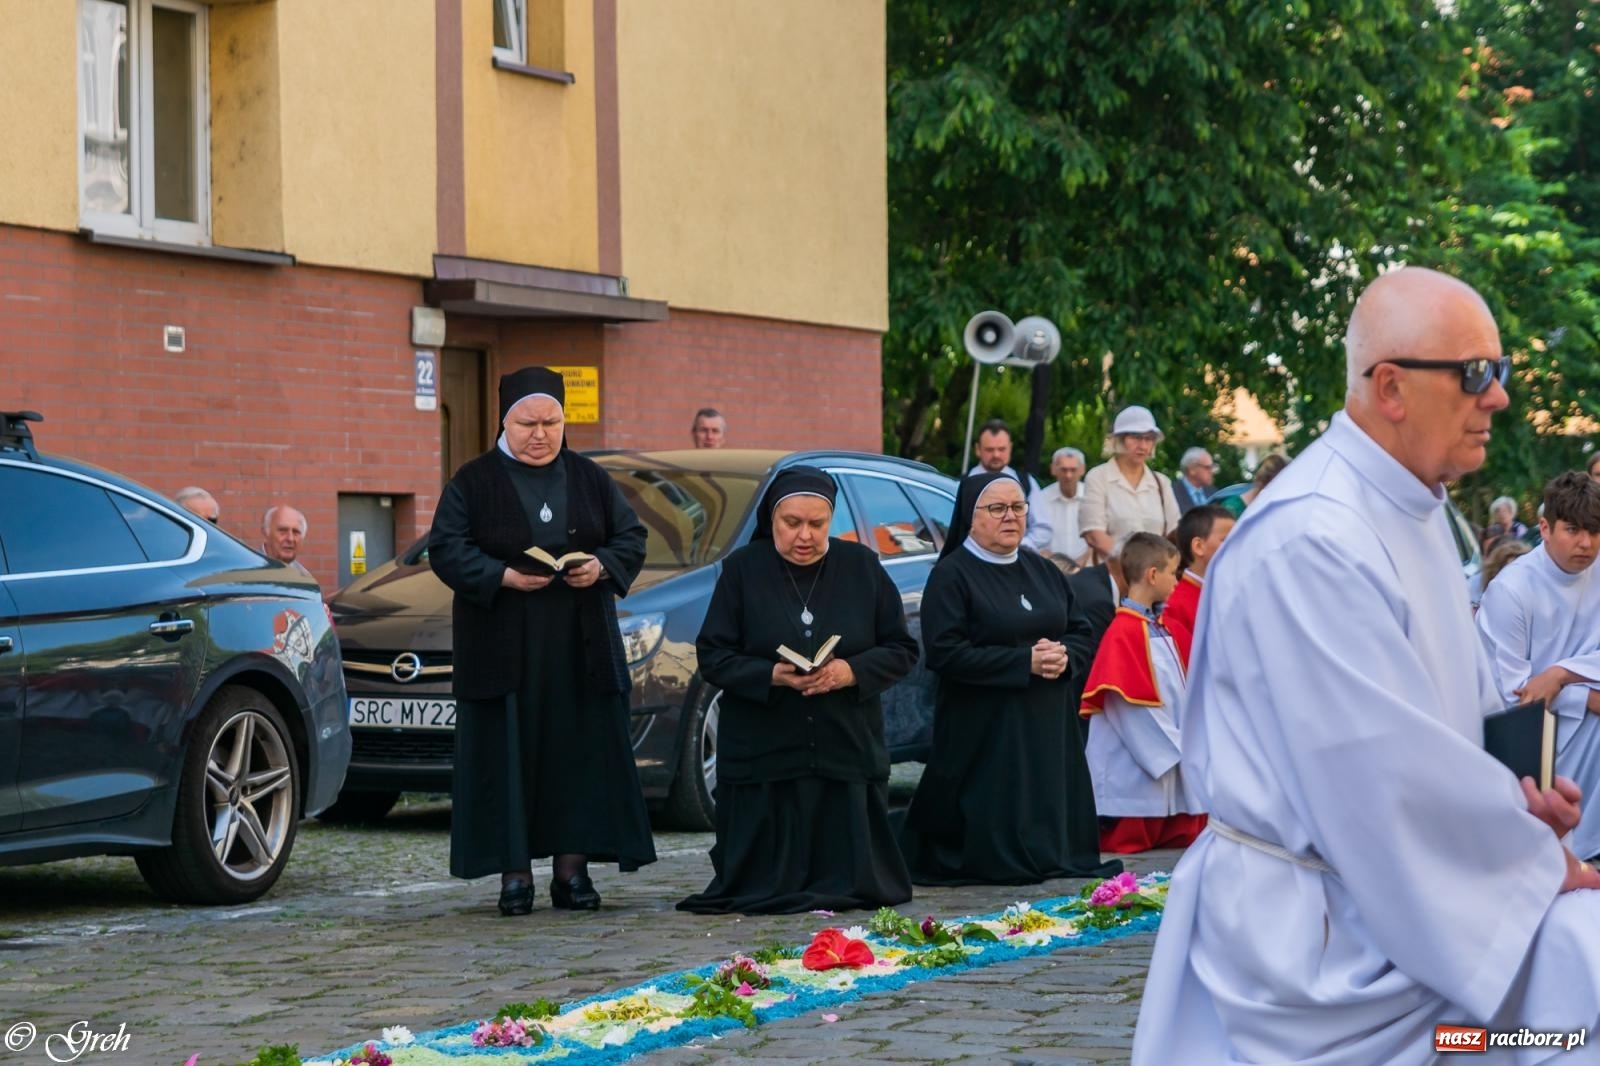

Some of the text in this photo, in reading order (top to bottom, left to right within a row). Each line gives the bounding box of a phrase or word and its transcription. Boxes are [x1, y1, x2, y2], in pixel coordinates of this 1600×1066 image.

[418, 360, 434, 384] 22
[354, 700, 457, 726] SRC MY22
